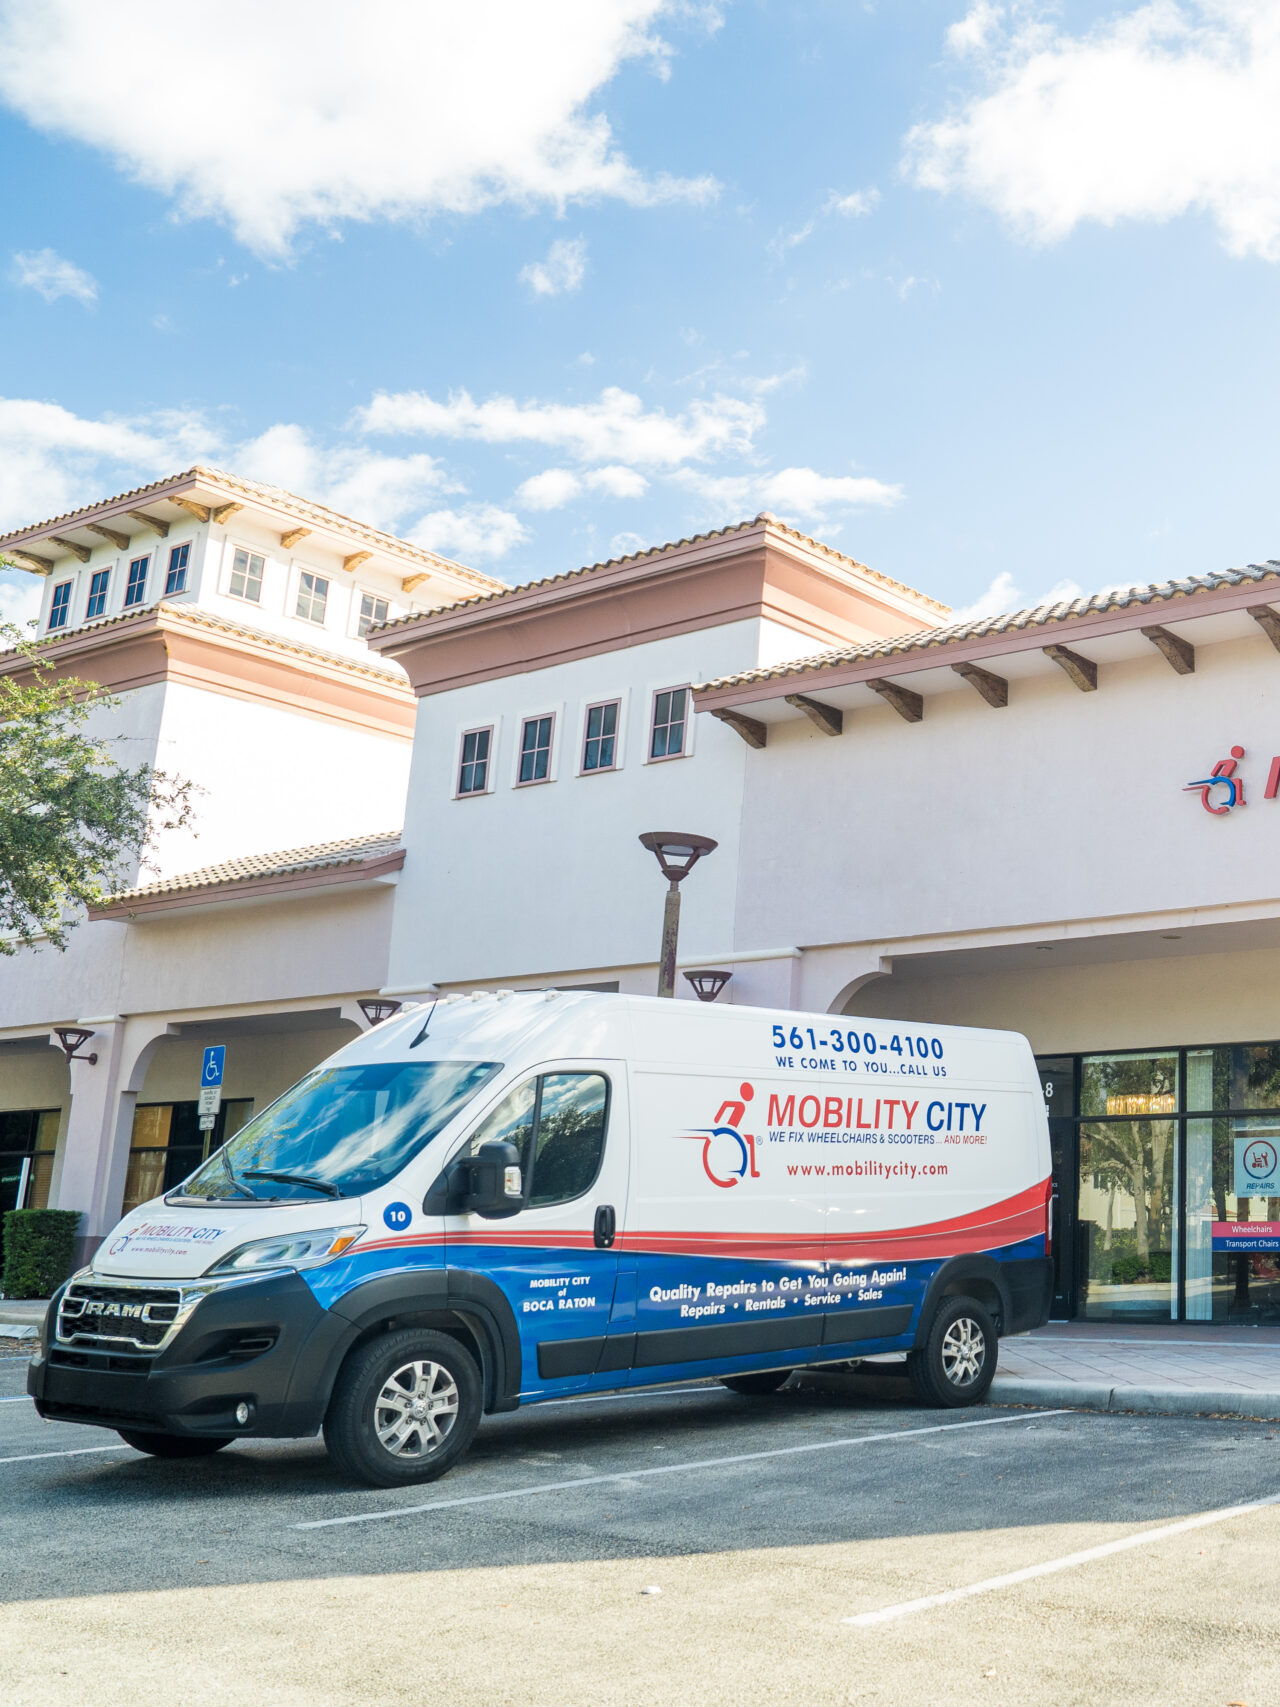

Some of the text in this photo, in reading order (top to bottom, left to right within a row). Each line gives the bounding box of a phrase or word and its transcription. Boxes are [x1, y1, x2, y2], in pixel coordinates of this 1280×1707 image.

[772, 1025, 944, 1060] 561-300-4100
[776, 1056, 794, 1068] WE
[800, 1057, 836, 1071] COME
[842, 1060, 857, 1072] TO
[932, 1066, 947, 1077] US
[767, 1094, 987, 1132] MOBILITY CITY
[769, 1131, 786, 1143] WE
[788, 1132, 804, 1142] FIX
[807, 1132, 878, 1144] WHEELCHAIRS
[879, 1134, 885, 1144] &
[962, 1135, 988, 1145] MORE!
[787, 1160, 948, 1180] www.mobilitycity.com
[1246, 1182, 1275, 1190] REPAIRS
[390, 1211, 405, 1222] 10
[140, 1226, 195, 1238] MOBILITY
[193, 1228, 226, 1240] CITY
[1226, 1239, 1279, 1248] Transport Chairs
[529, 1276, 591, 1288] MOBILITY CITY
[649, 1267, 907, 1302] Quality Repairs to Get You Going Again!
[558, 1288, 567, 1296] of
[85, 1302, 144, 1318] RAM
[523, 1297, 596, 1312] BOCA RATON
[680, 1288, 883, 1319] Repairs Rentals Service Sales
